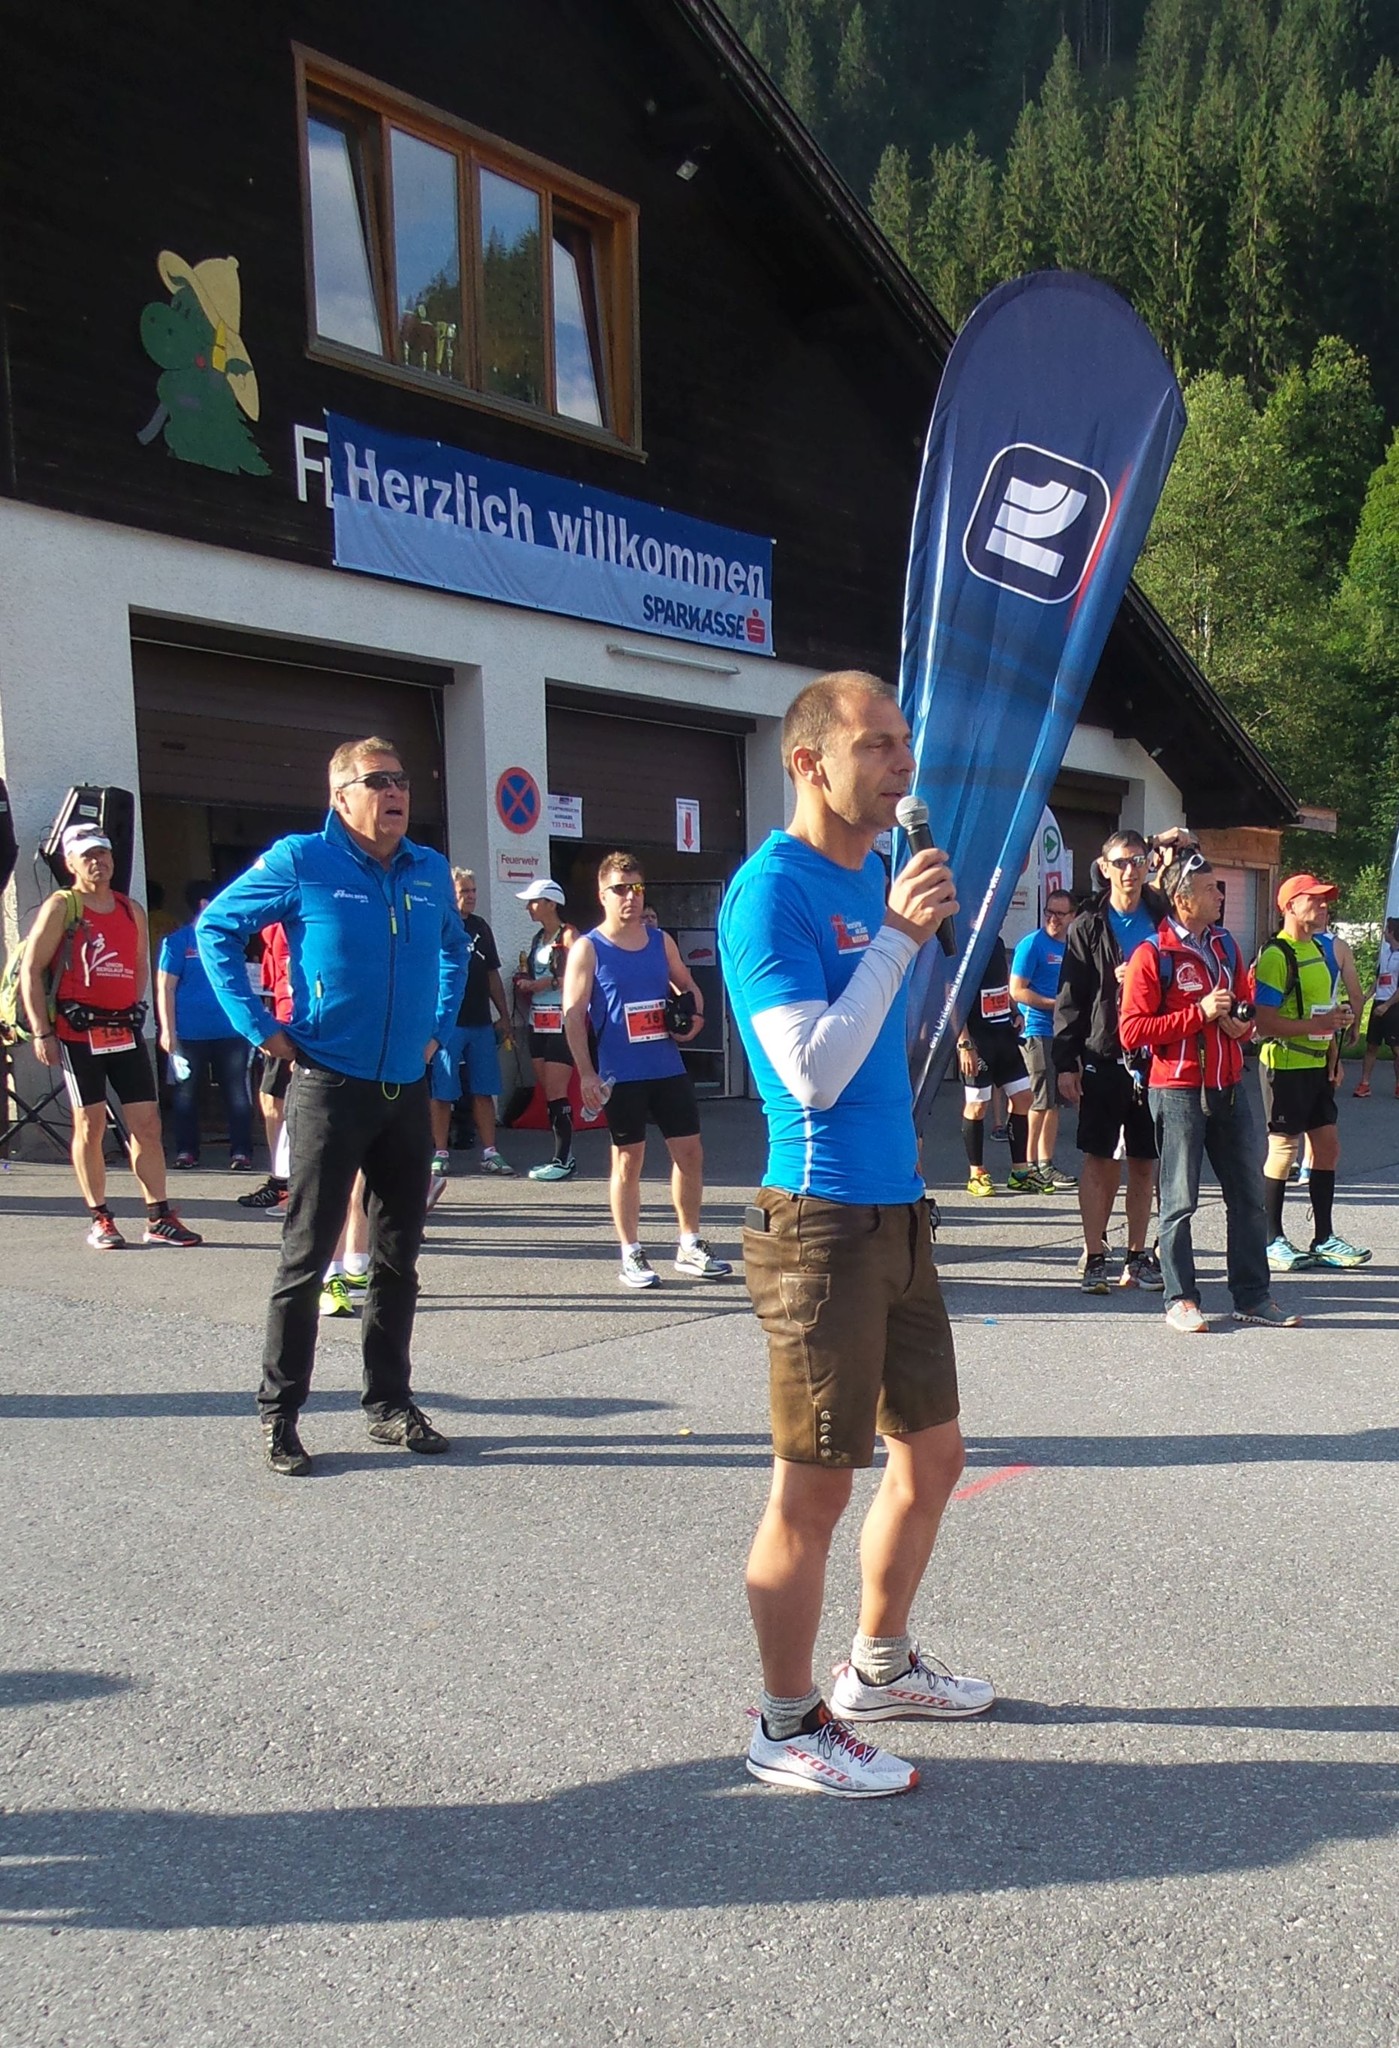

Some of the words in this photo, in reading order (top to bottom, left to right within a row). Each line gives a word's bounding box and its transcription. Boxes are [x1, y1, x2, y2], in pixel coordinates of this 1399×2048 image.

[344, 442, 535, 544] Herzlich
[549, 506, 765, 599] willkommen
[643, 594, 745, 640] SPARKASSE
[501, 853, 539, 866] Feuerwehr
[929, 1031, 941, 1049] ein
[881, 1689, 951, 1706] SCOTT
[782, 1745, 852, 1783] SCOTT
